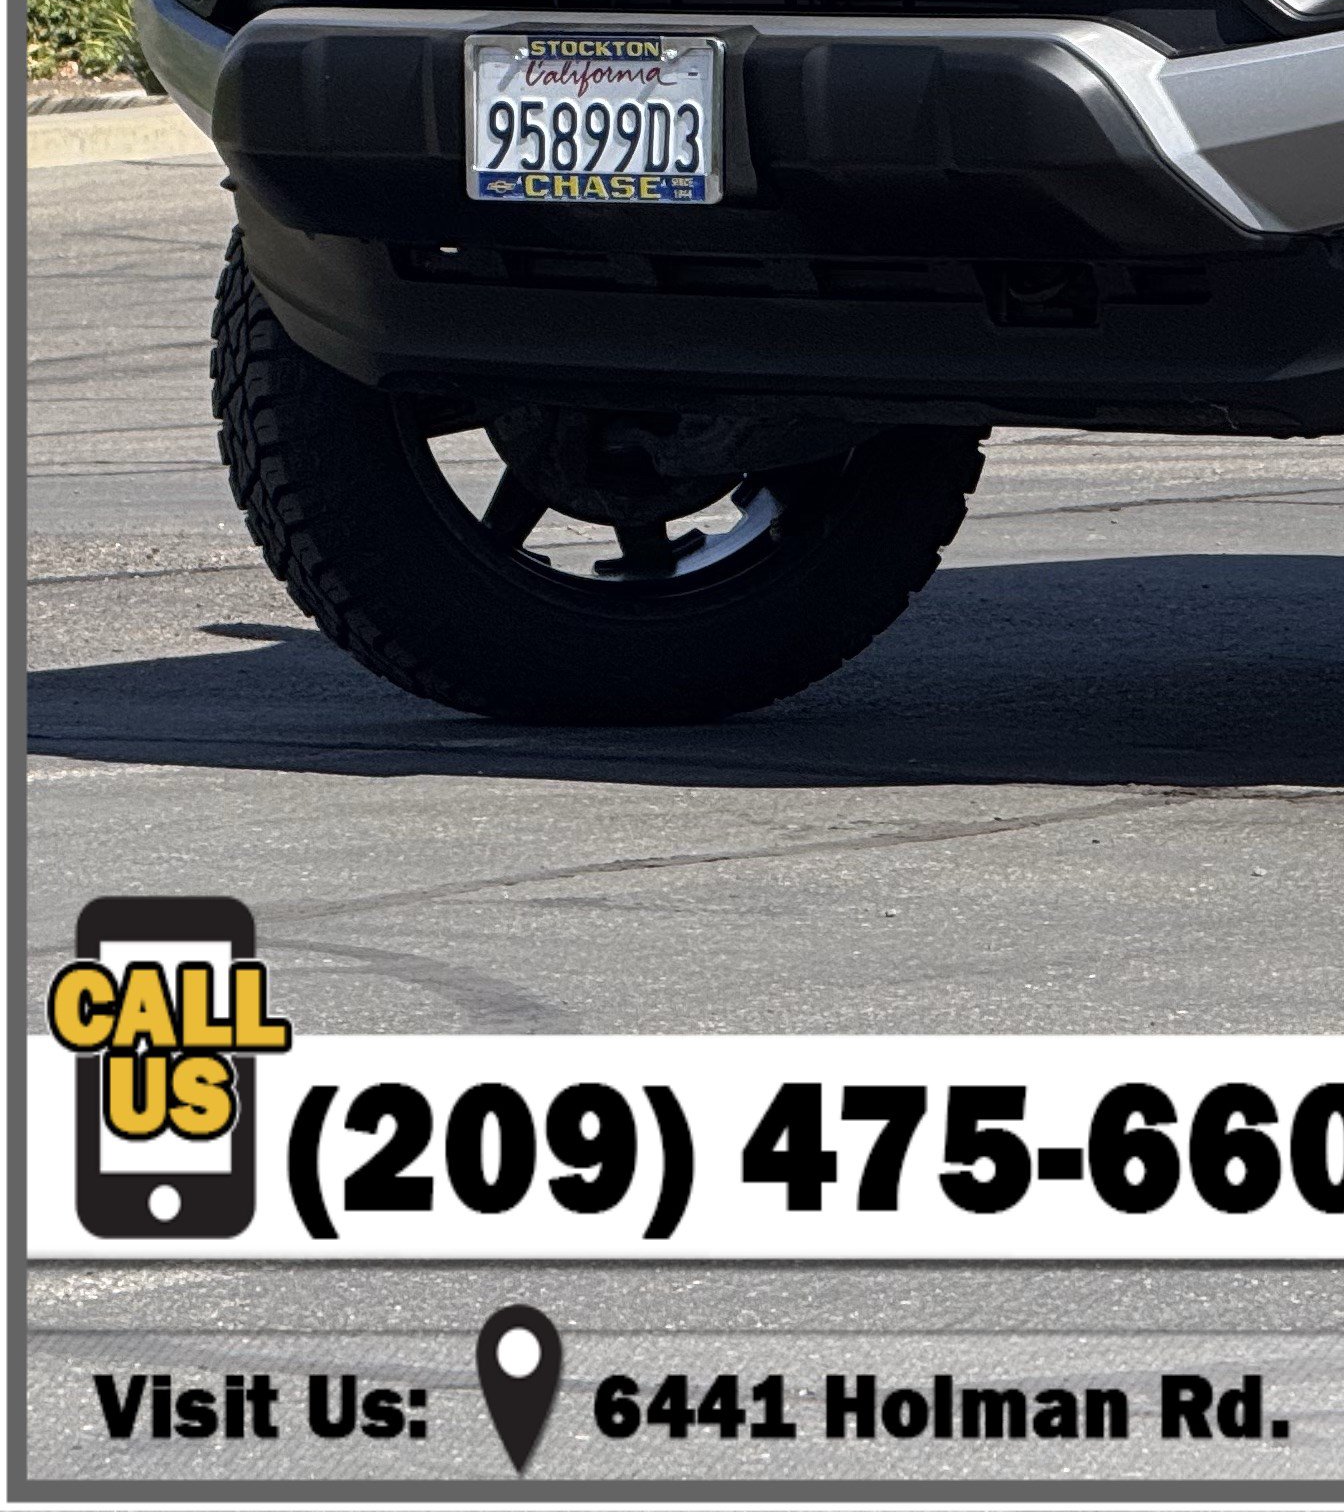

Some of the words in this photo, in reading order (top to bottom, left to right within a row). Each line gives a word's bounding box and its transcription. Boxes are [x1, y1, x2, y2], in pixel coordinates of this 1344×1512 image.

[529, 41, 661, 57] STOCKTON
[525, 60, 678, 98] California
[487, 100, 701, 174] 95899D3
[524, 175, 662, 199] CHASE
